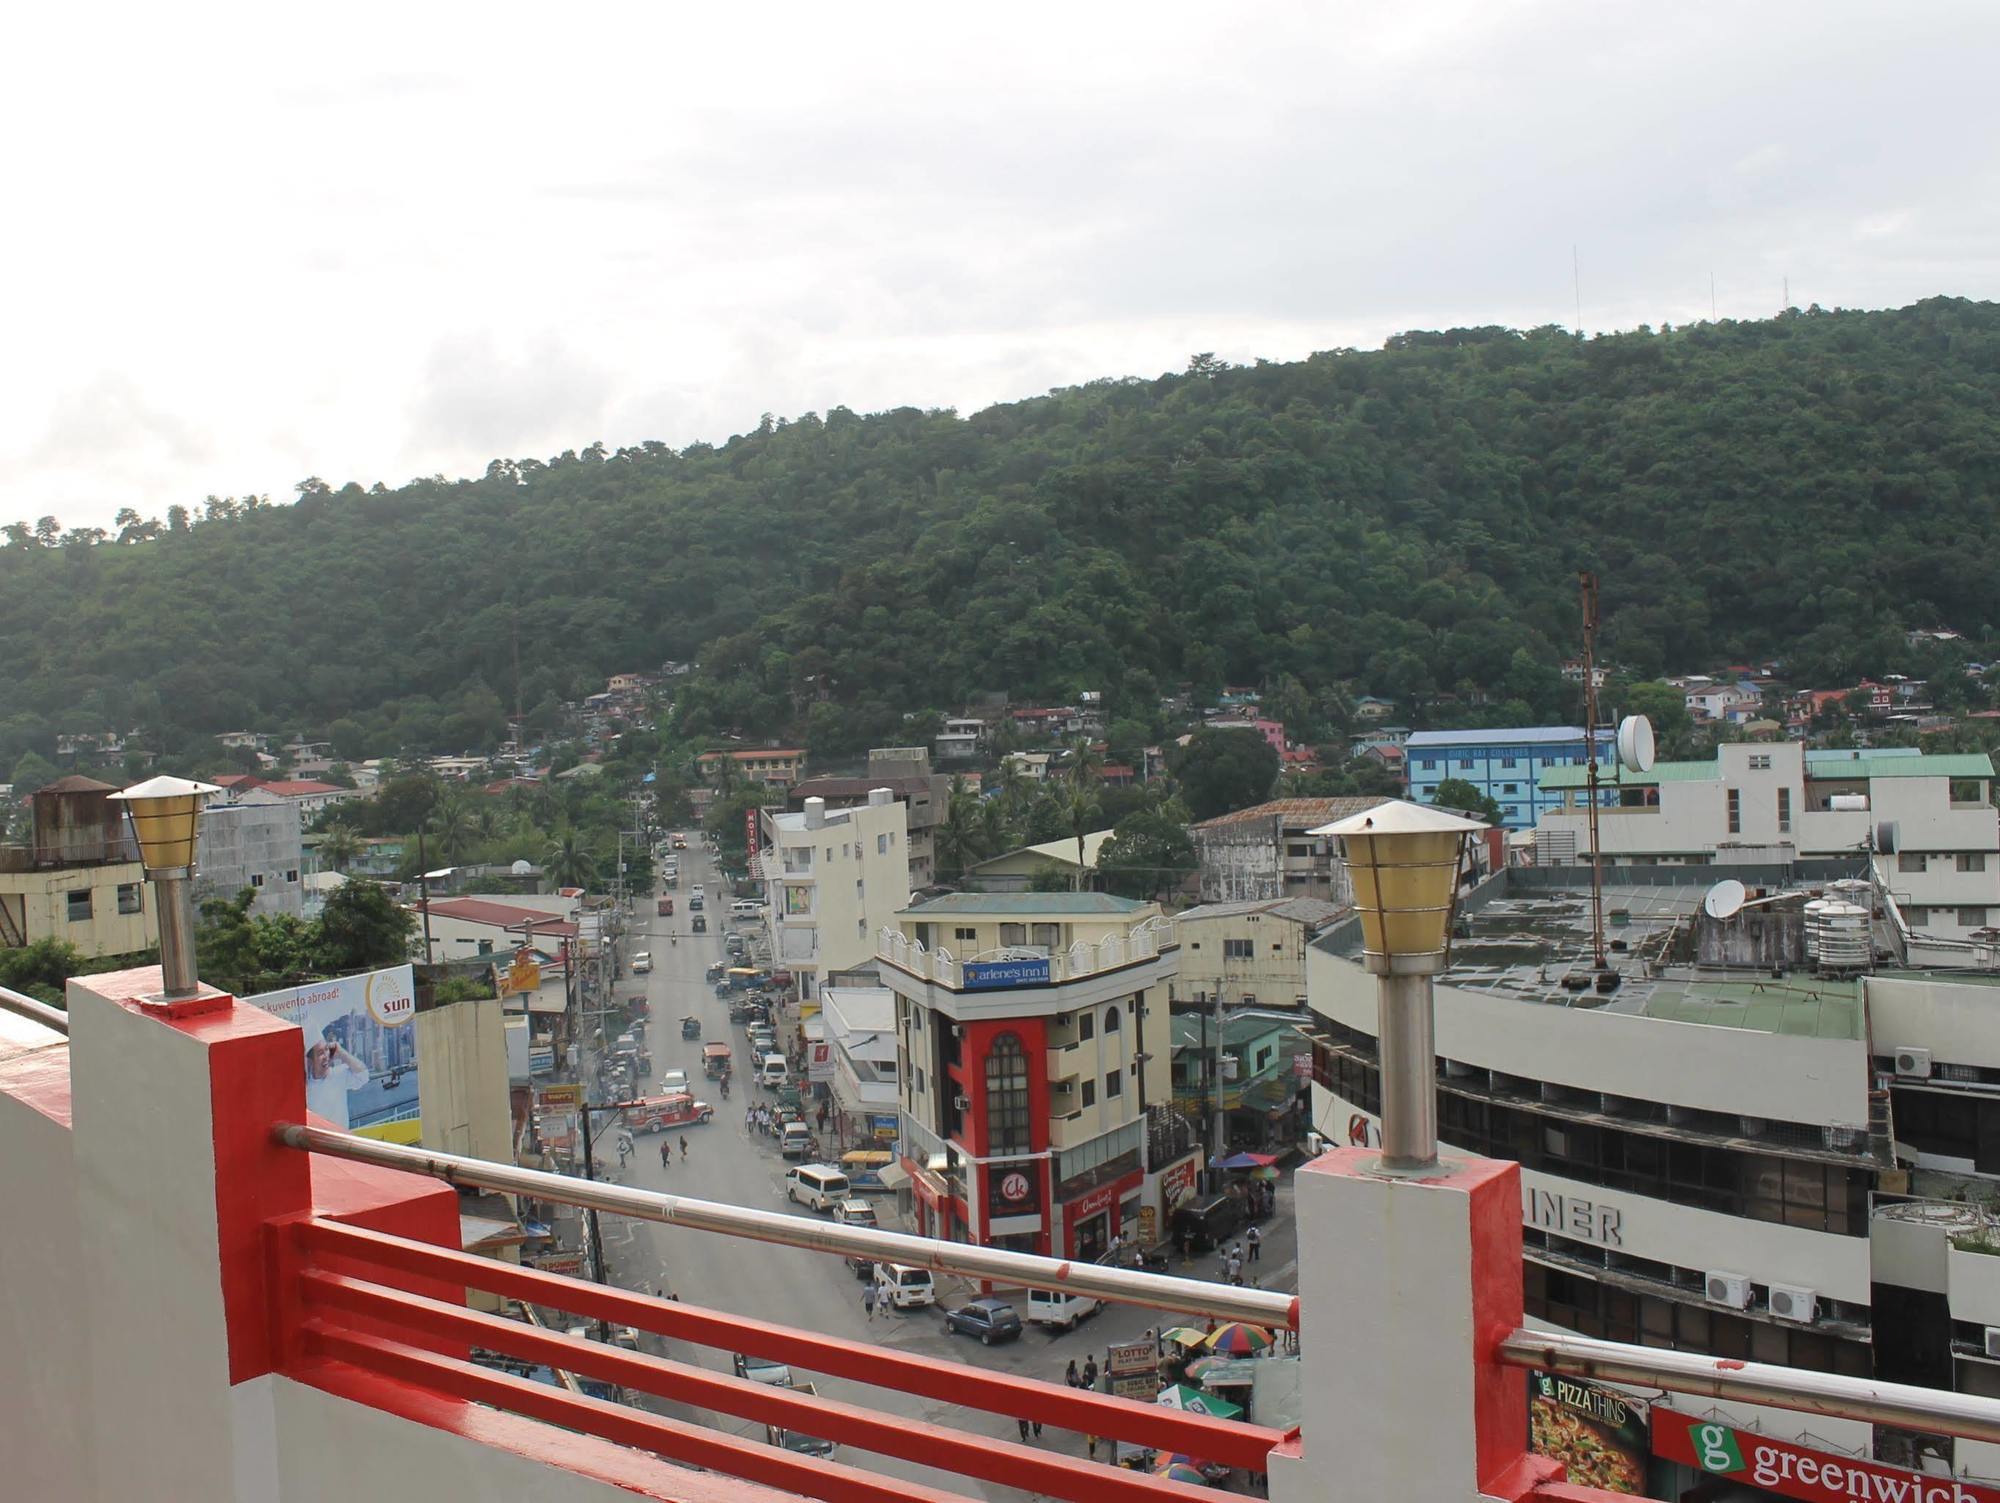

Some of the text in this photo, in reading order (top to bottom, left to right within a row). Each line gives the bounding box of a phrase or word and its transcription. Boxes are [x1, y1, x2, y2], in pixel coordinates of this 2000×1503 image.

[1022, 966, 1040, 977] inn
[383, 997, 410, 1014] sun
[1118, 1347, 1149, 1359] LOTTO
[1701, 1425, 1731, 1470] g
